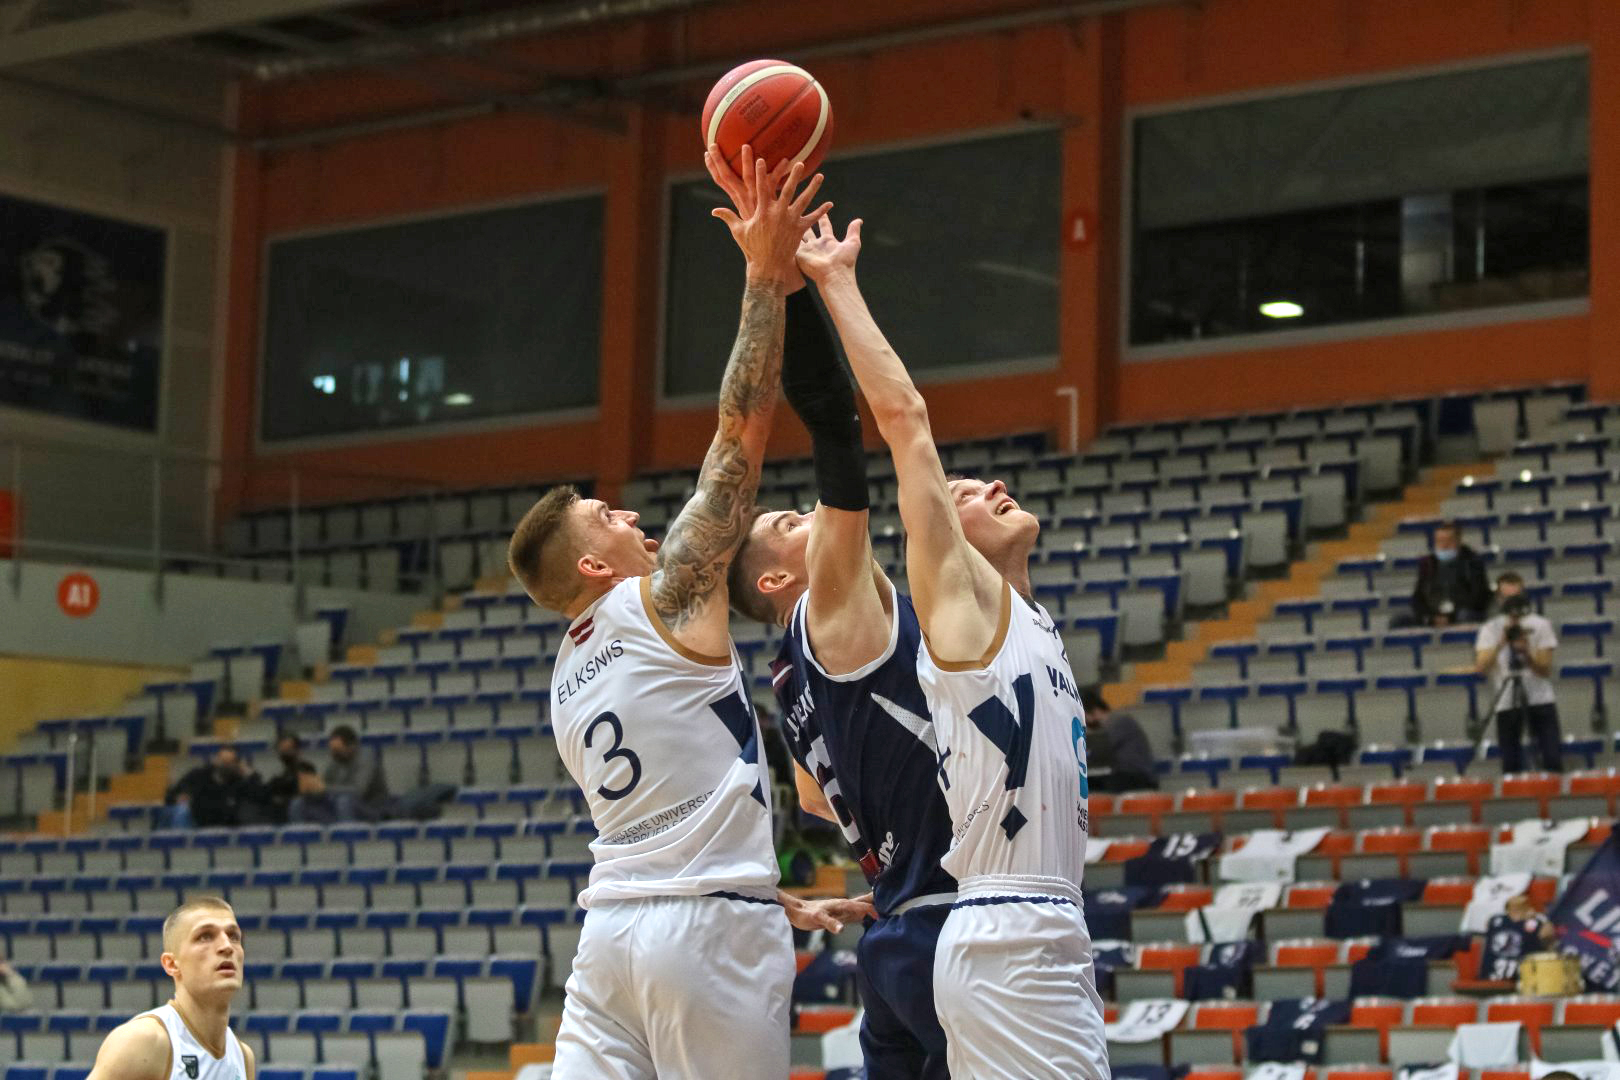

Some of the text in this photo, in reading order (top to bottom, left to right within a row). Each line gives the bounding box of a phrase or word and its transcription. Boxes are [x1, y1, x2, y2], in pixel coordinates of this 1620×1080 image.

[67, 584, 90, 608] A1
[557, 639, 624, 705] ELKSNIS
[584, 711, 642, 801] 3
[1162, 832, 1198, 858] 15
[1136, 1004, 1171, 1025] 13
